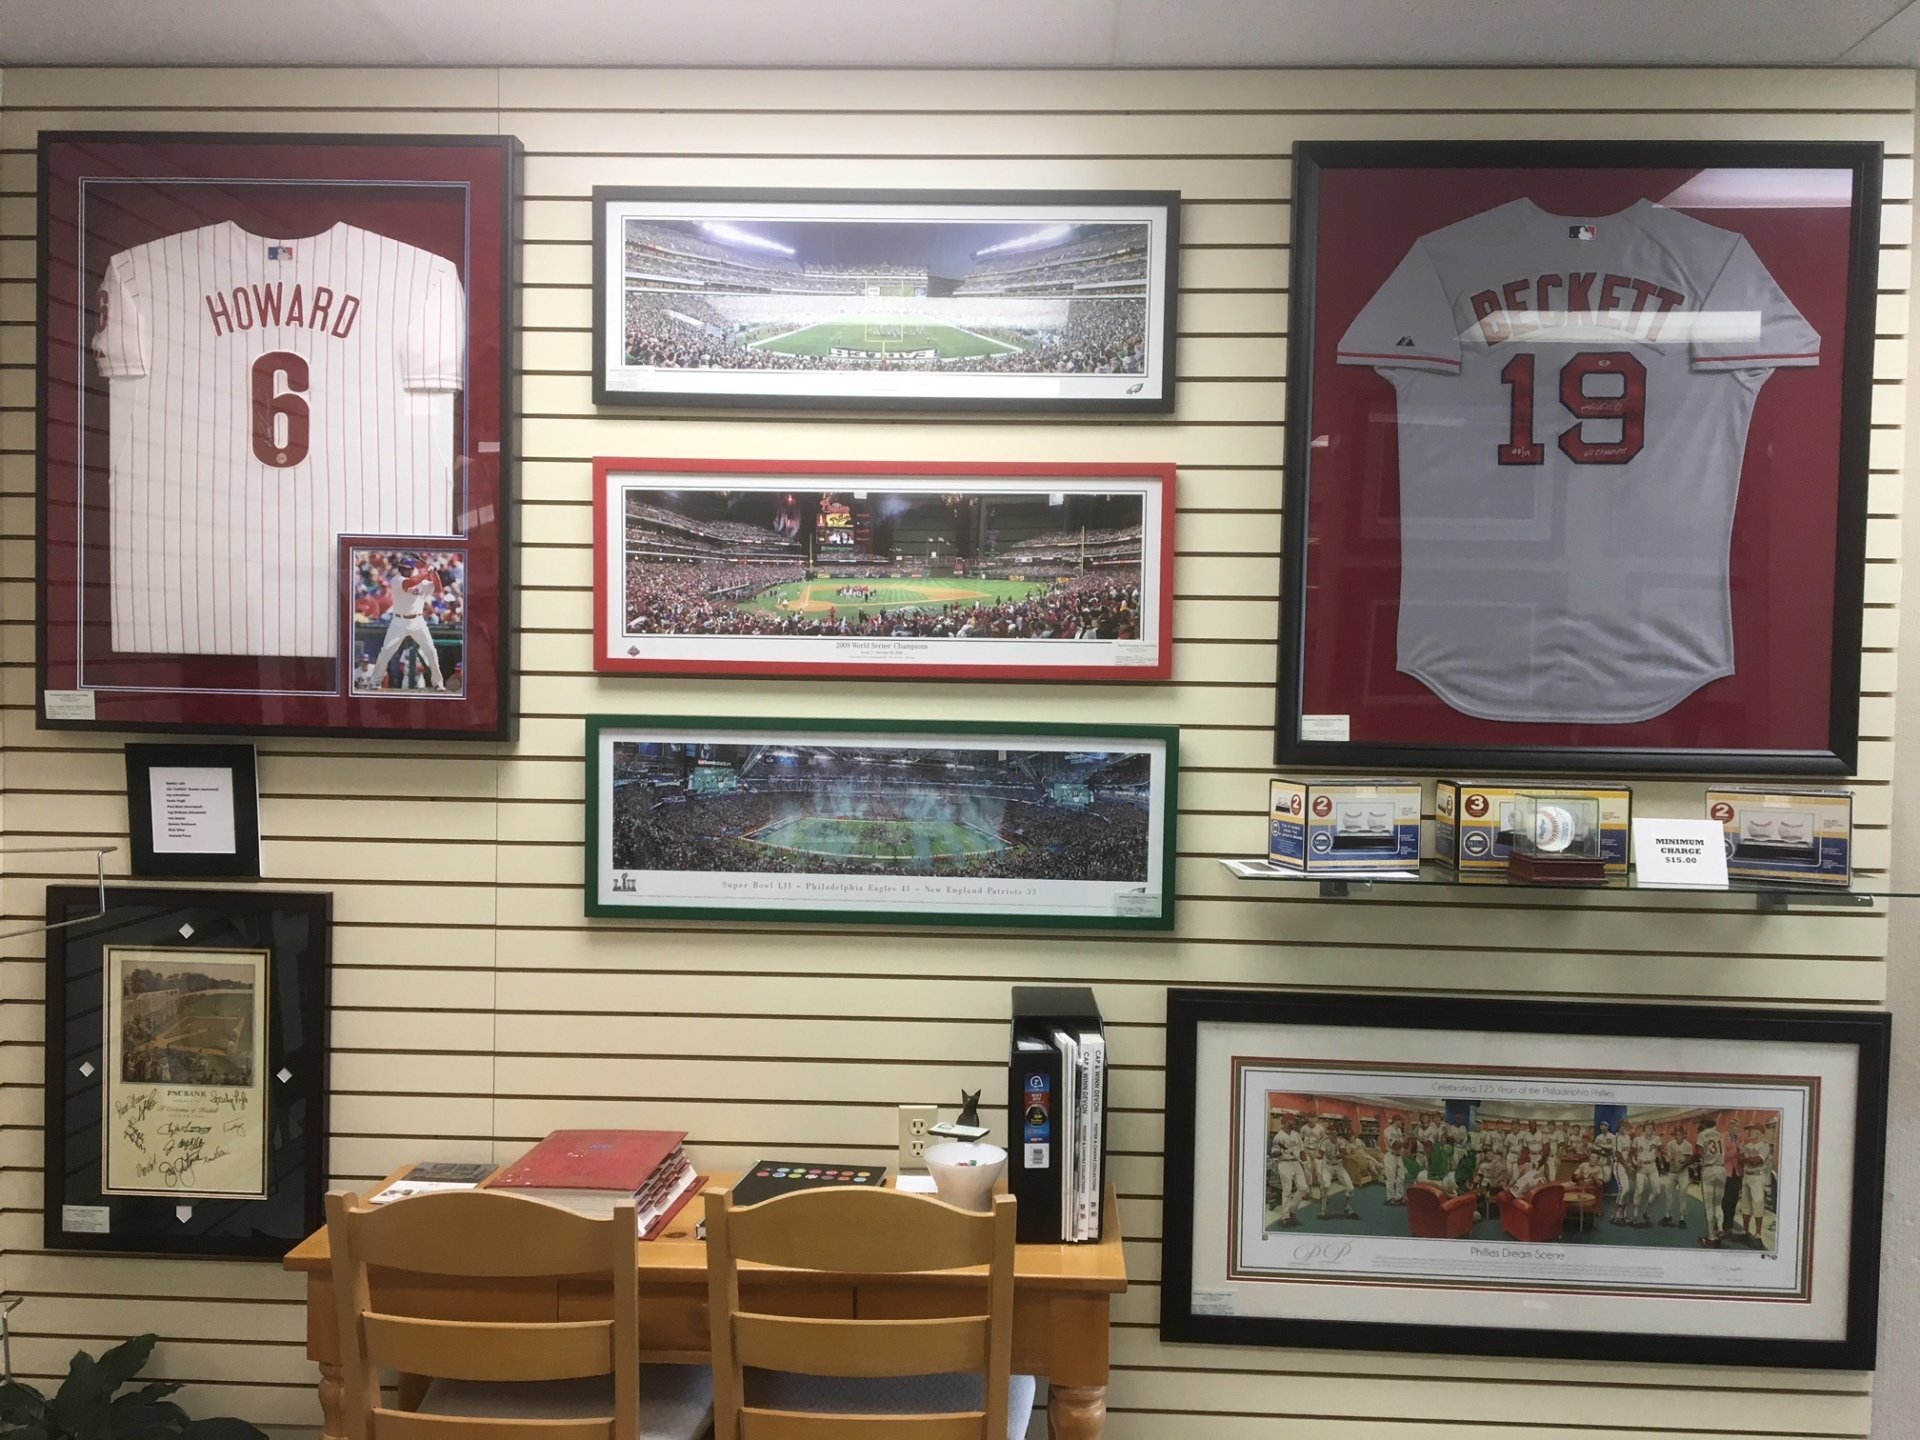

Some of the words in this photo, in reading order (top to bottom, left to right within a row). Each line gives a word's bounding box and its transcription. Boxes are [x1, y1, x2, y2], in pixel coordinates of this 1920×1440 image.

[206, 281, 360, 339] HOWARD
[1470, 272, 1685, 346] BECKETT
[252, 351, 310, 468] 6
[1498, 352, 1647, 465] 19
[893, 642, 929, 651] Champions
[1292, 796, 1301, 809] 2
[1316, 796, 1329, 811] 2
[1470, 795, 1485, 811] 3
[1715, 804, 1730, 817] 2
[1655, 838, 1704, 846] MINIMUM
[1660, 846, 1702, 855] CHARGE
[1665, 856, 1697, 864] $15.00
[722, 881, 748, 891] Super
[753, 881, 773, 889] Bowl
[778, 882, 792, 890] LII
[806, 882, 864, 893] Philadelphia
[868, 883, 897, 894] Eagles
[900, 884, 910, 893] 41
[925, 885, 941, 893] New
[946, 885, 983, 896] England
[987, 887, 1023, 896] Patriots
[1431, 1082, 1476, 1093] Celebrating
[1497, 1085, 1517, 1094] Years
[1518, 1086, 1527, 1095] of
[1529, 1086, 1540, 1095] the
[1542, 1087, 1589, 1098] Philadelphia
[1590, 1088, 1615, 1097] Phillies
[1708, 1139, 1723, 1155] 31
[1470, 1246, 1499, 1257] Phillies
[1502, 1247, 1532, 1259] Dream
[1535, 1249, 1565, 1260] Scene
